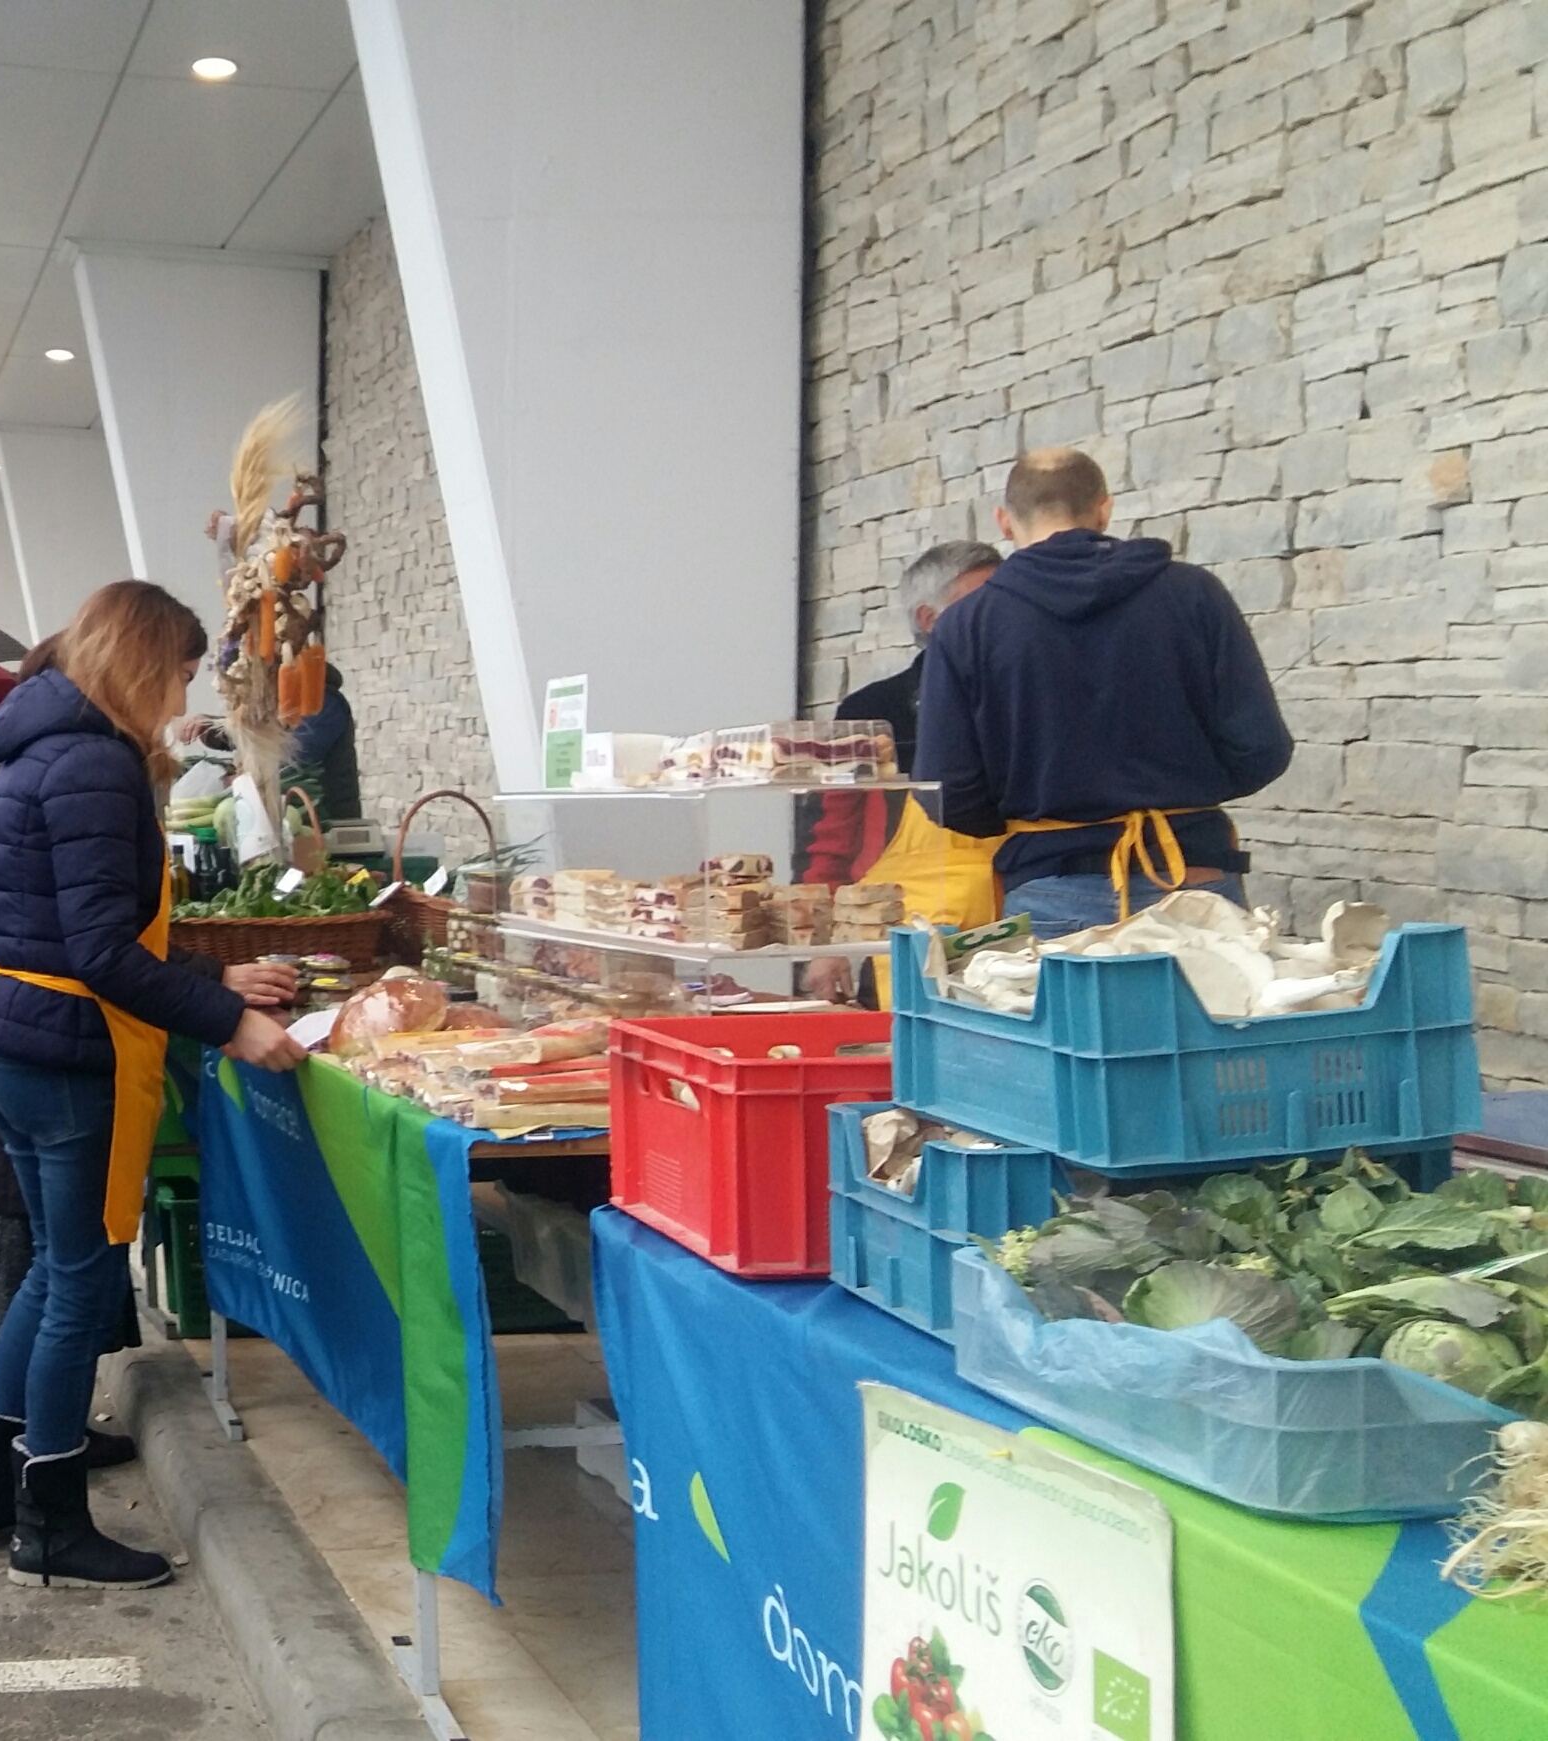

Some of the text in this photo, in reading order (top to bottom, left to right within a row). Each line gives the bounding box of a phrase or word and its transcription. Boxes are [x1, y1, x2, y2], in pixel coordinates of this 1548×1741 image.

[877, 1410, 942, 1453] EKOLOŠKO
[878, 1520, 1003, 1637] Jakoliš
[1025, 1618, 1065, 1668] eko
